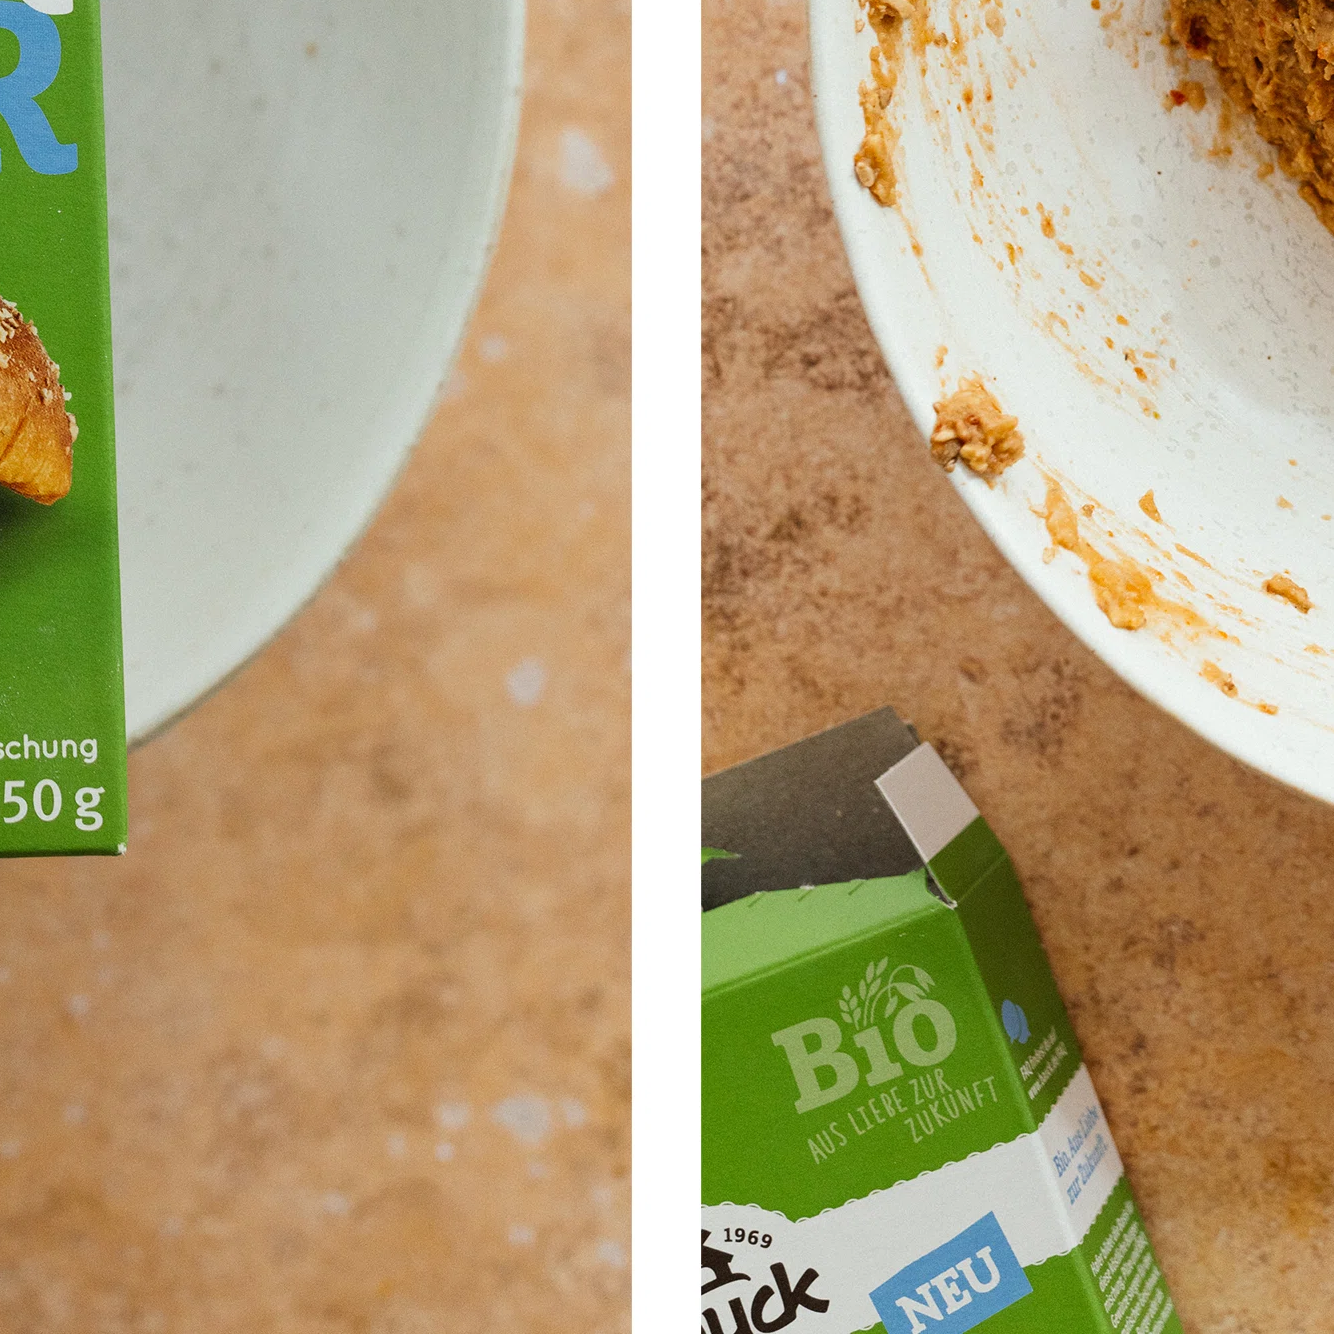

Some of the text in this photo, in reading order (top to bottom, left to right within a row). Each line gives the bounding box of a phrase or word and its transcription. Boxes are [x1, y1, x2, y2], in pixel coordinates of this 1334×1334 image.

[74, 786, 105, 832] g
[770, 999, 957, 1115] Bio
[807, 1068, 953, 1165] AUS LIEBE ZUR
[904, 1075, 998, 1144] ZUKUNFT
[723, 1227, 773, 1249] 1969
[895, 1245, 1001, 1334] NEU
